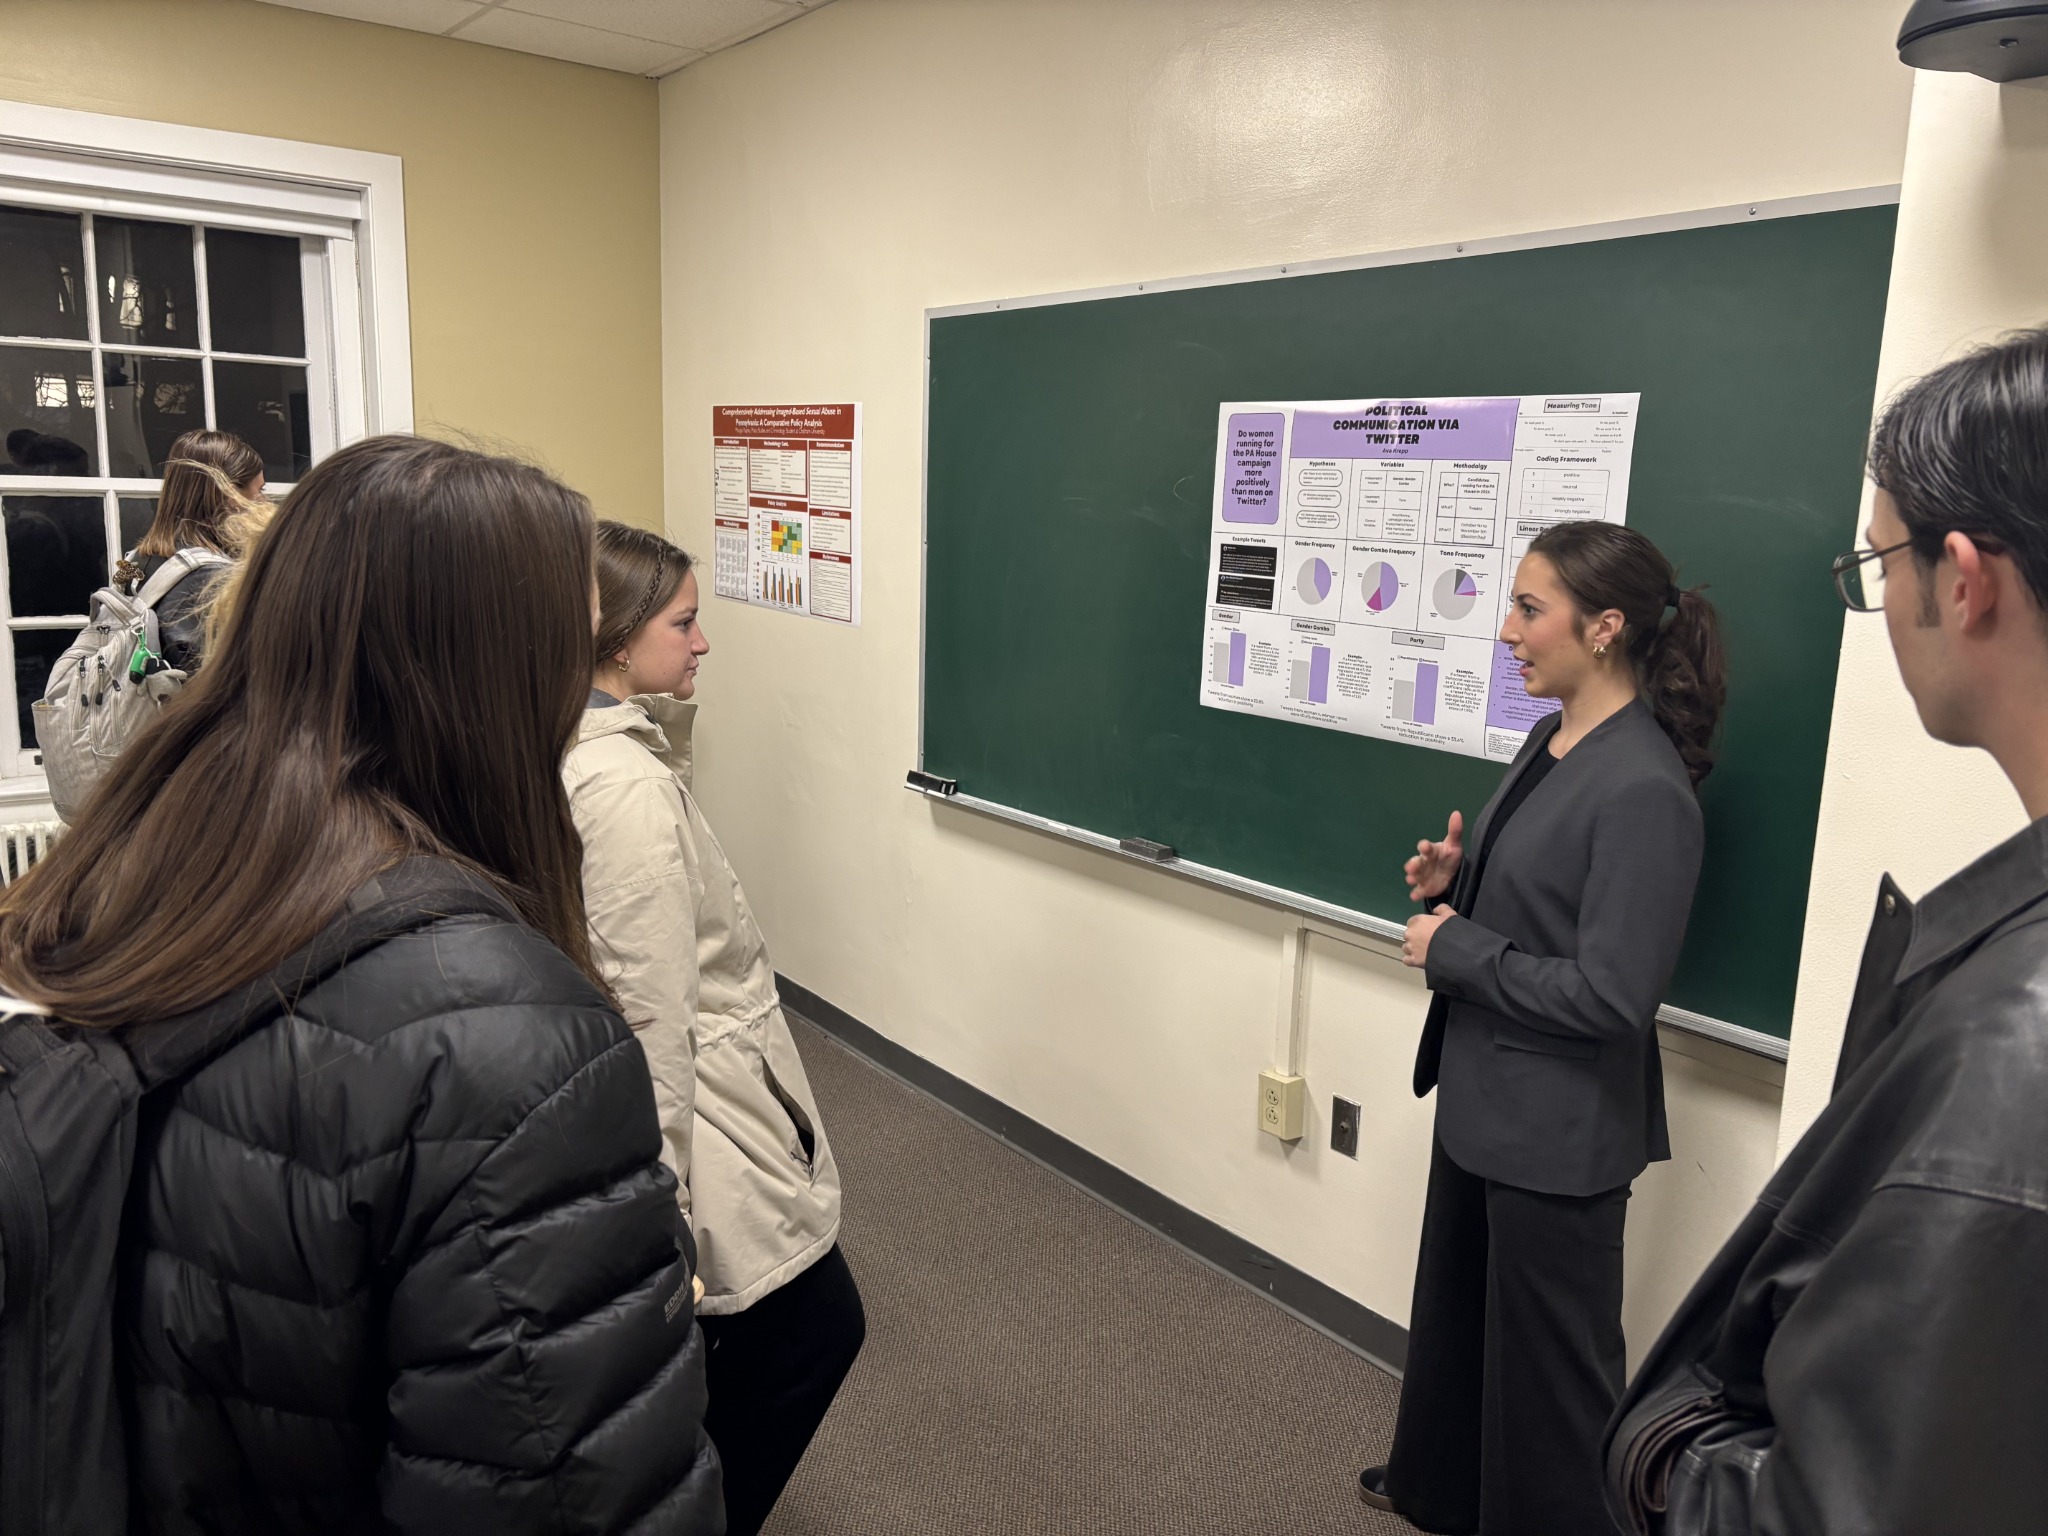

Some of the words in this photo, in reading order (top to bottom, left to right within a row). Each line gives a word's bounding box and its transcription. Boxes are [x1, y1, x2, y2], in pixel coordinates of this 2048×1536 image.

[806, 407, 821, 415] Sexual
[821, 407, 836, 415] Abuse
[837, 407, 842, 415] in
[1365, 405, 1428, 416] POLITICAL
[764, 418, 789, 428] Comparative
[791, 419, 803, 429] Policy
[804, 419, 822, 429] Analysis
[1333, 419, 1436, 430] COMMUNICATION
[1438, 419, 1459, 430] VIA
[1237, 439, 1262, 448] running
[1366, 434, 1420, 444] TWITTER
[1237, 460, 1271, 468] campaign
[1236, 478, 1270, 487] positively
[1237, 497, 1267, 506] Twitter?
[1389, 548, 1416, 556] Frequency
[1455, 551, 1485, 559] Frequency
